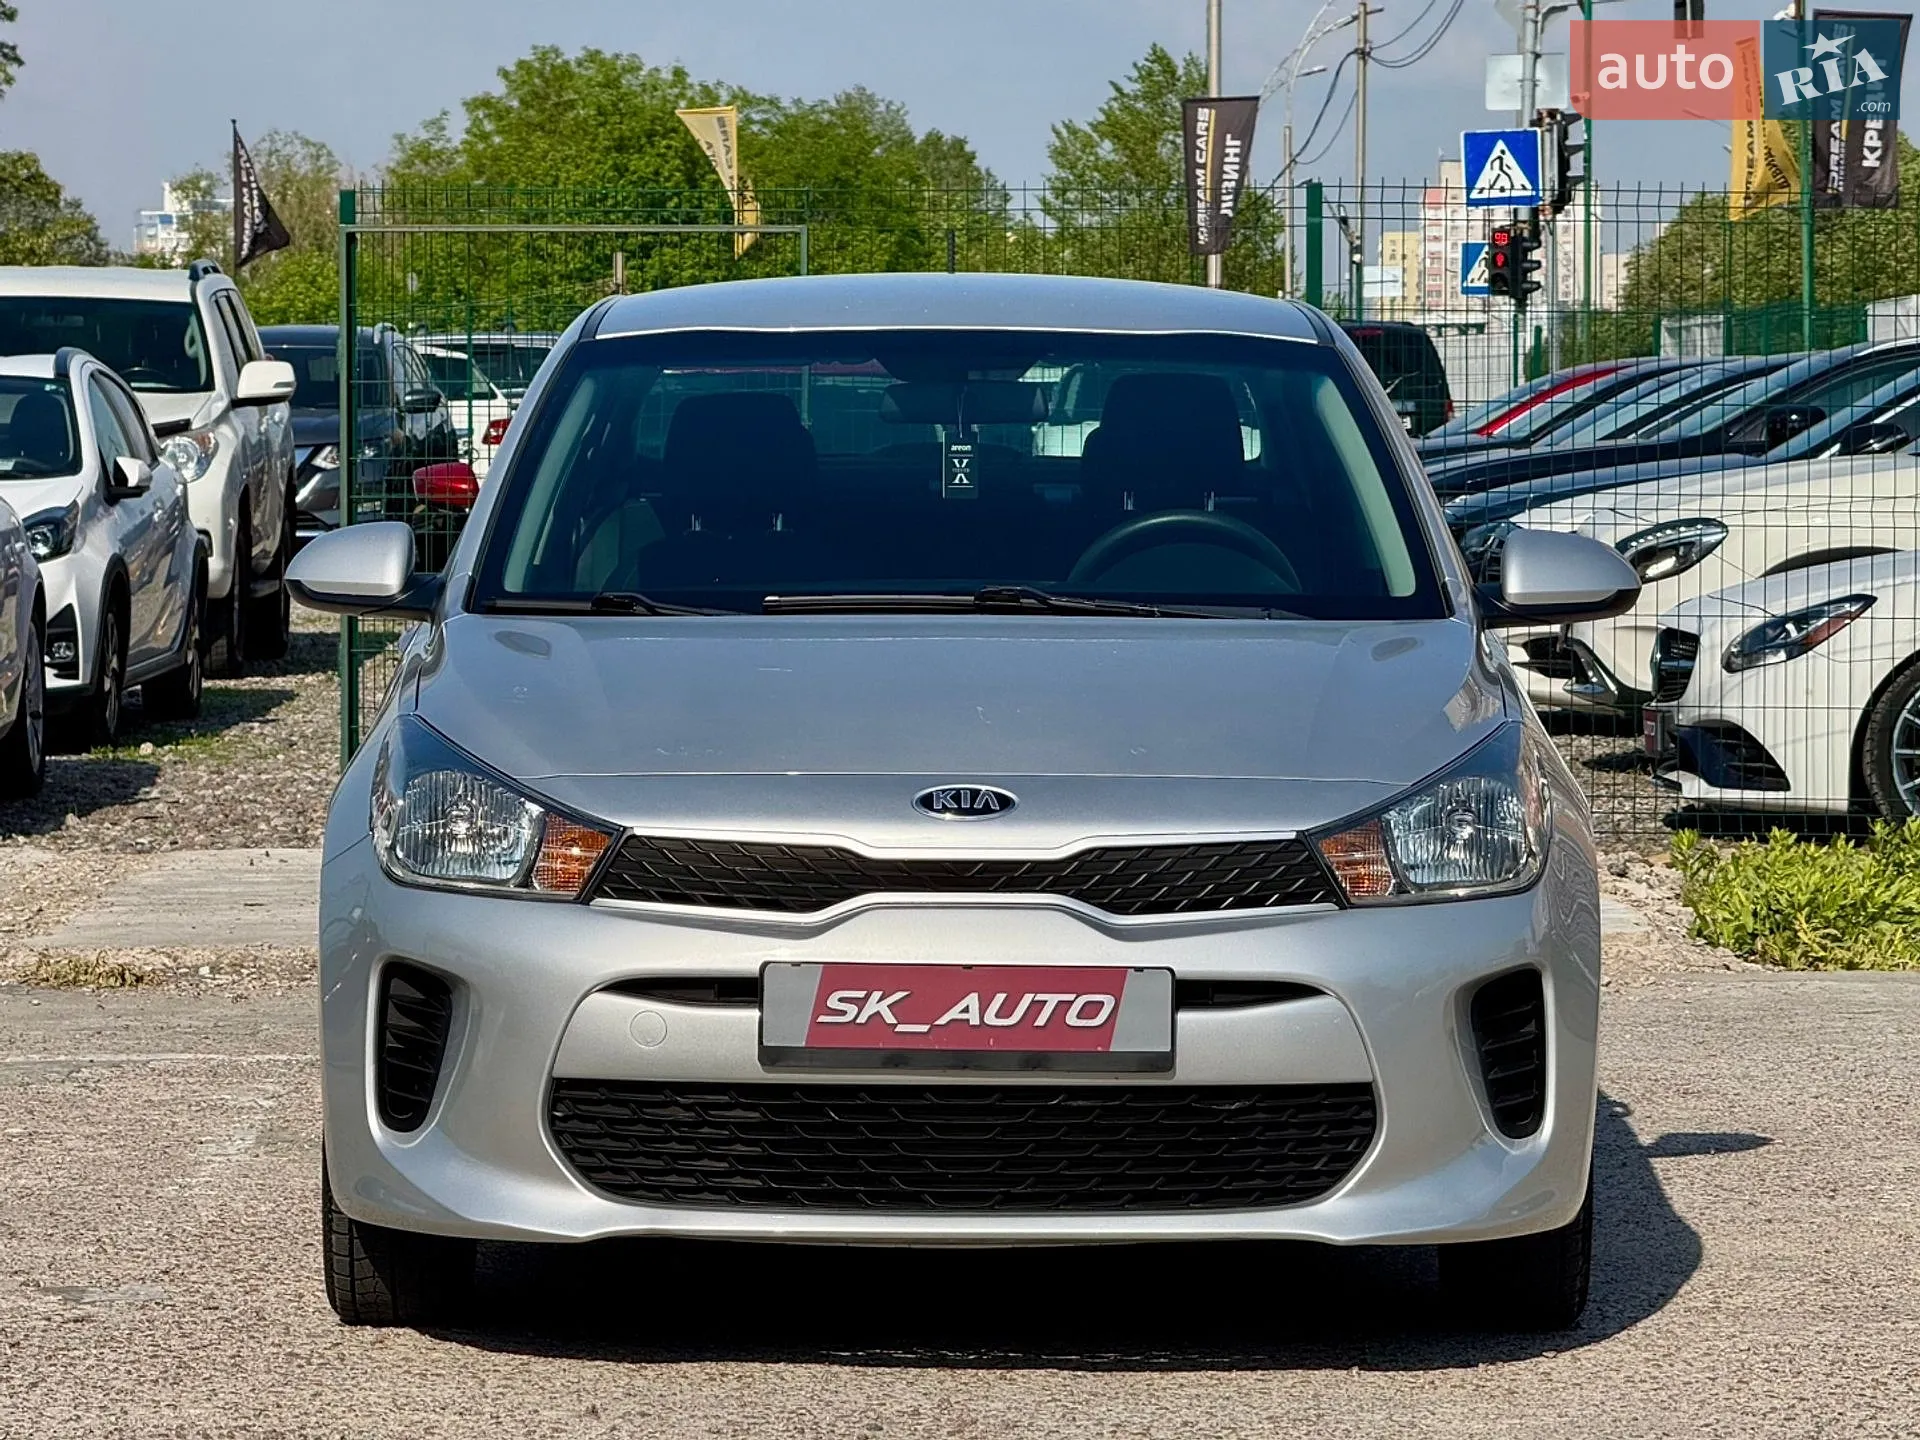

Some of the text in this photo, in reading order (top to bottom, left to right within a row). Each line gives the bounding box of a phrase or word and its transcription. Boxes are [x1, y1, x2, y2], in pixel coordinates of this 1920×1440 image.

[1196, 107, 1210, 164] CARS
[932, 789, 1000, 811] KIA
[816, 989, 1116, 1033] SK_AUTO
